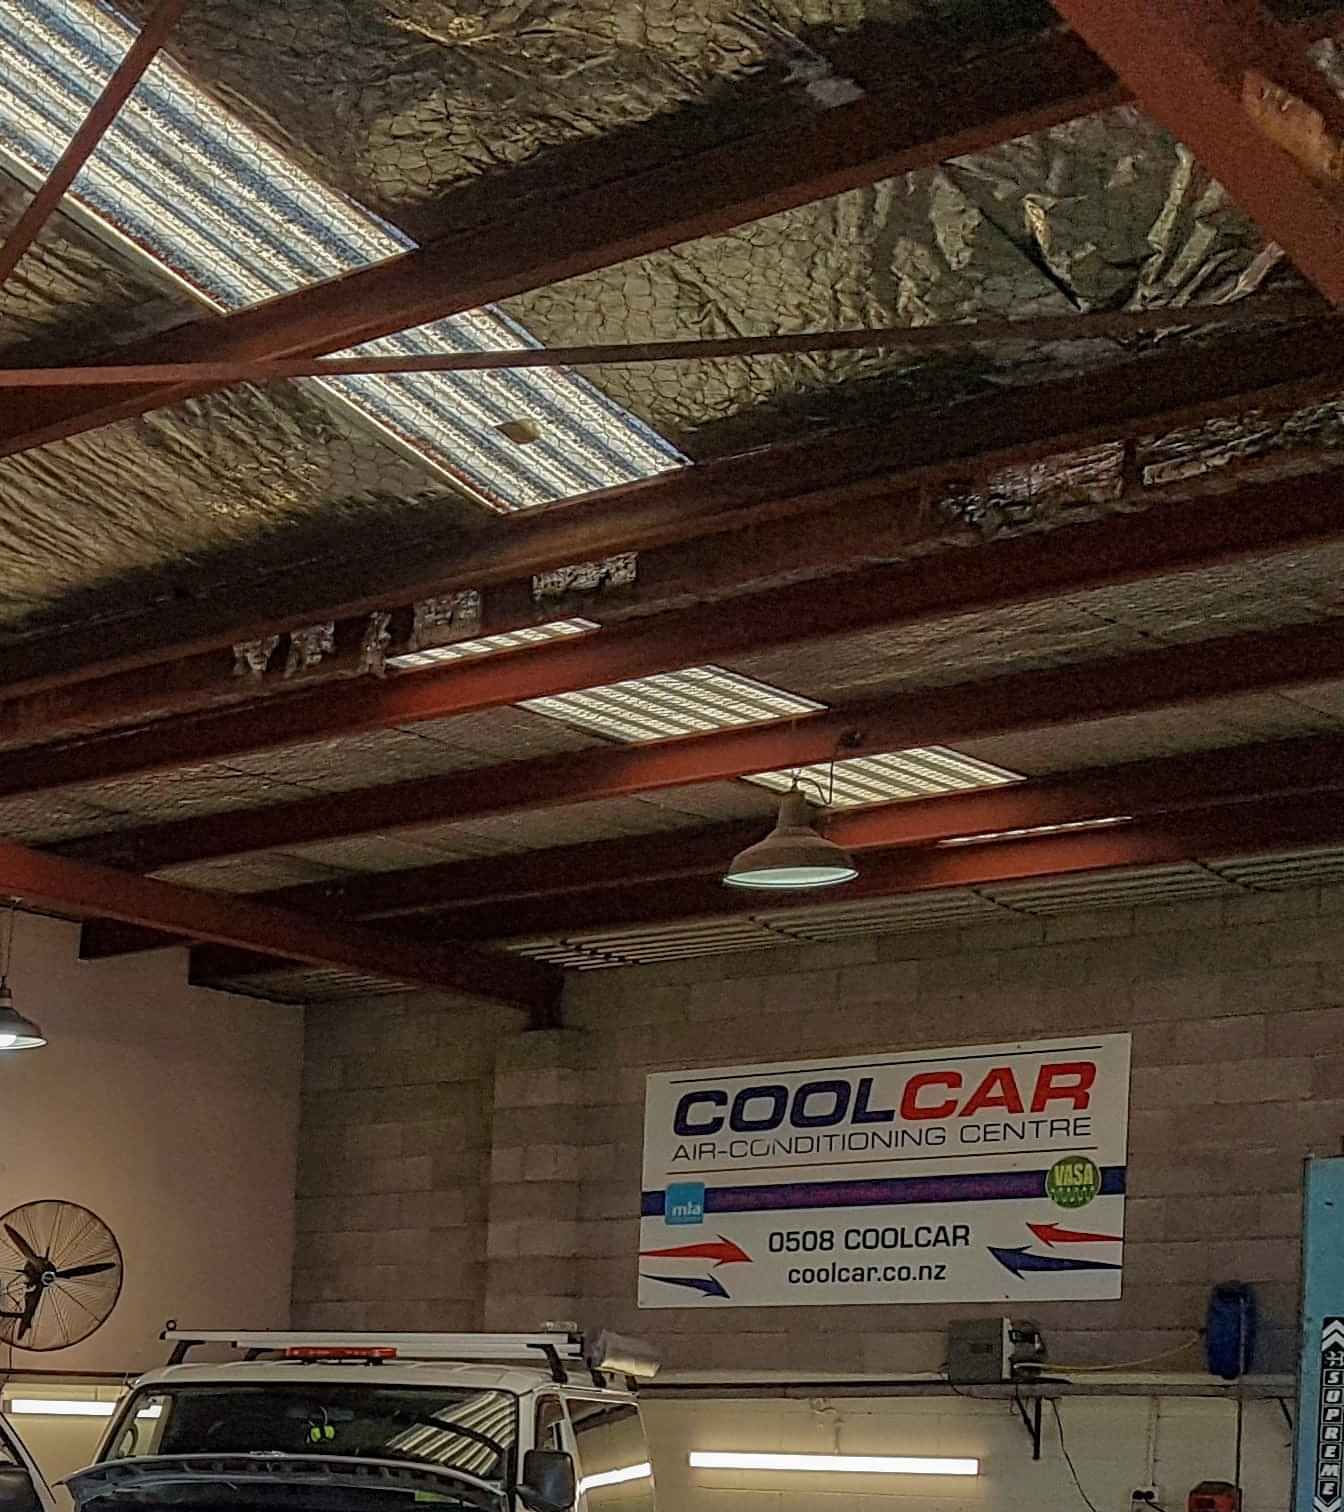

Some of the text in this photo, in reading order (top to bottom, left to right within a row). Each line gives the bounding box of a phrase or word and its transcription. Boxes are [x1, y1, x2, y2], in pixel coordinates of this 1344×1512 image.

[672, 1061, 1098, 1138] COOLCAR
[671, 1117, 1092, 1162] AIR-CONDITIONING CENTRE
[1055, 1162, 1094, 1187] VASA
[768, 1224, 971, 1253] 0508 COOLCAR
[787, 1261, 947, 1285] coolcar.co.nz
[1321, 1371, 1341, 1496] SUPREME
